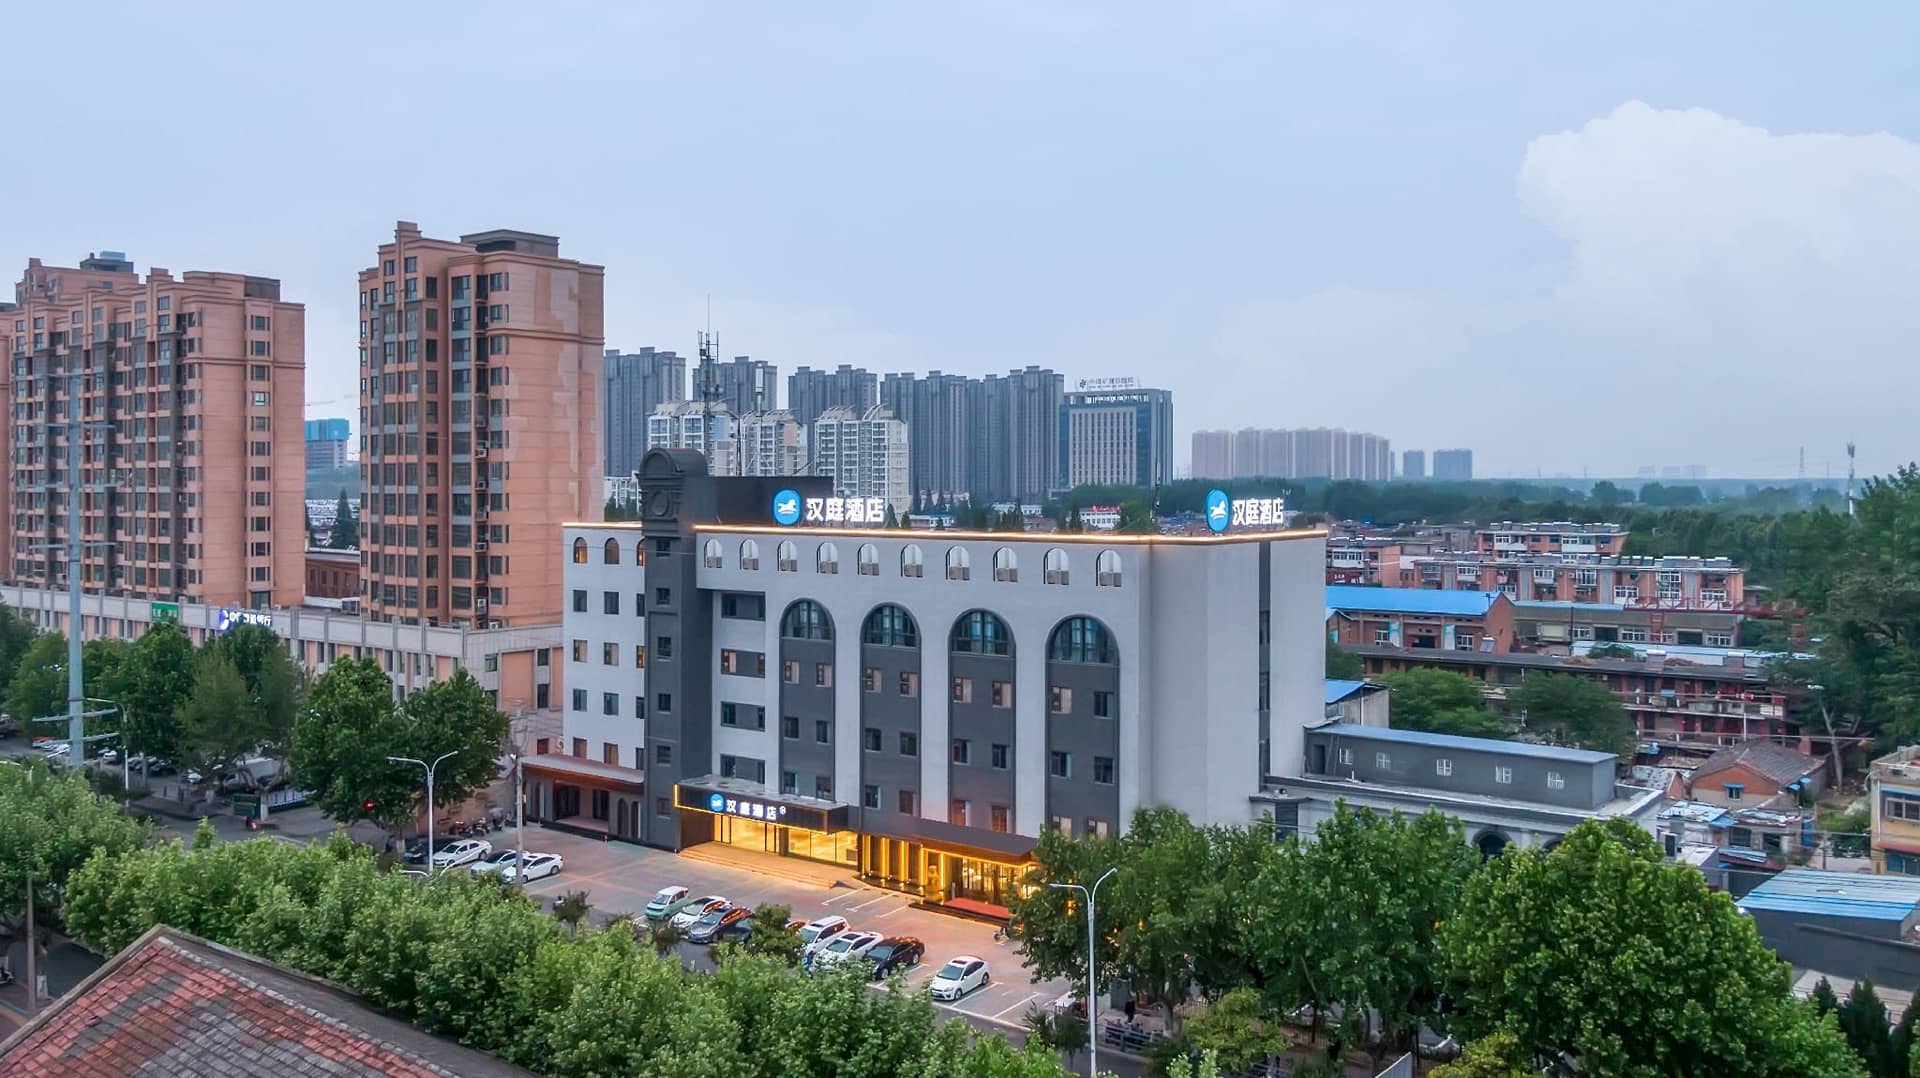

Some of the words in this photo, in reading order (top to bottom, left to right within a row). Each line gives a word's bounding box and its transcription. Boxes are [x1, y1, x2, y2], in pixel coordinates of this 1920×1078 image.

[806, 497, 884, 522] 汉庭酒店
[1232, 498, 1284, 525] 汉庭酒店
[726, 799, 777, 820] 汉庭酒店
